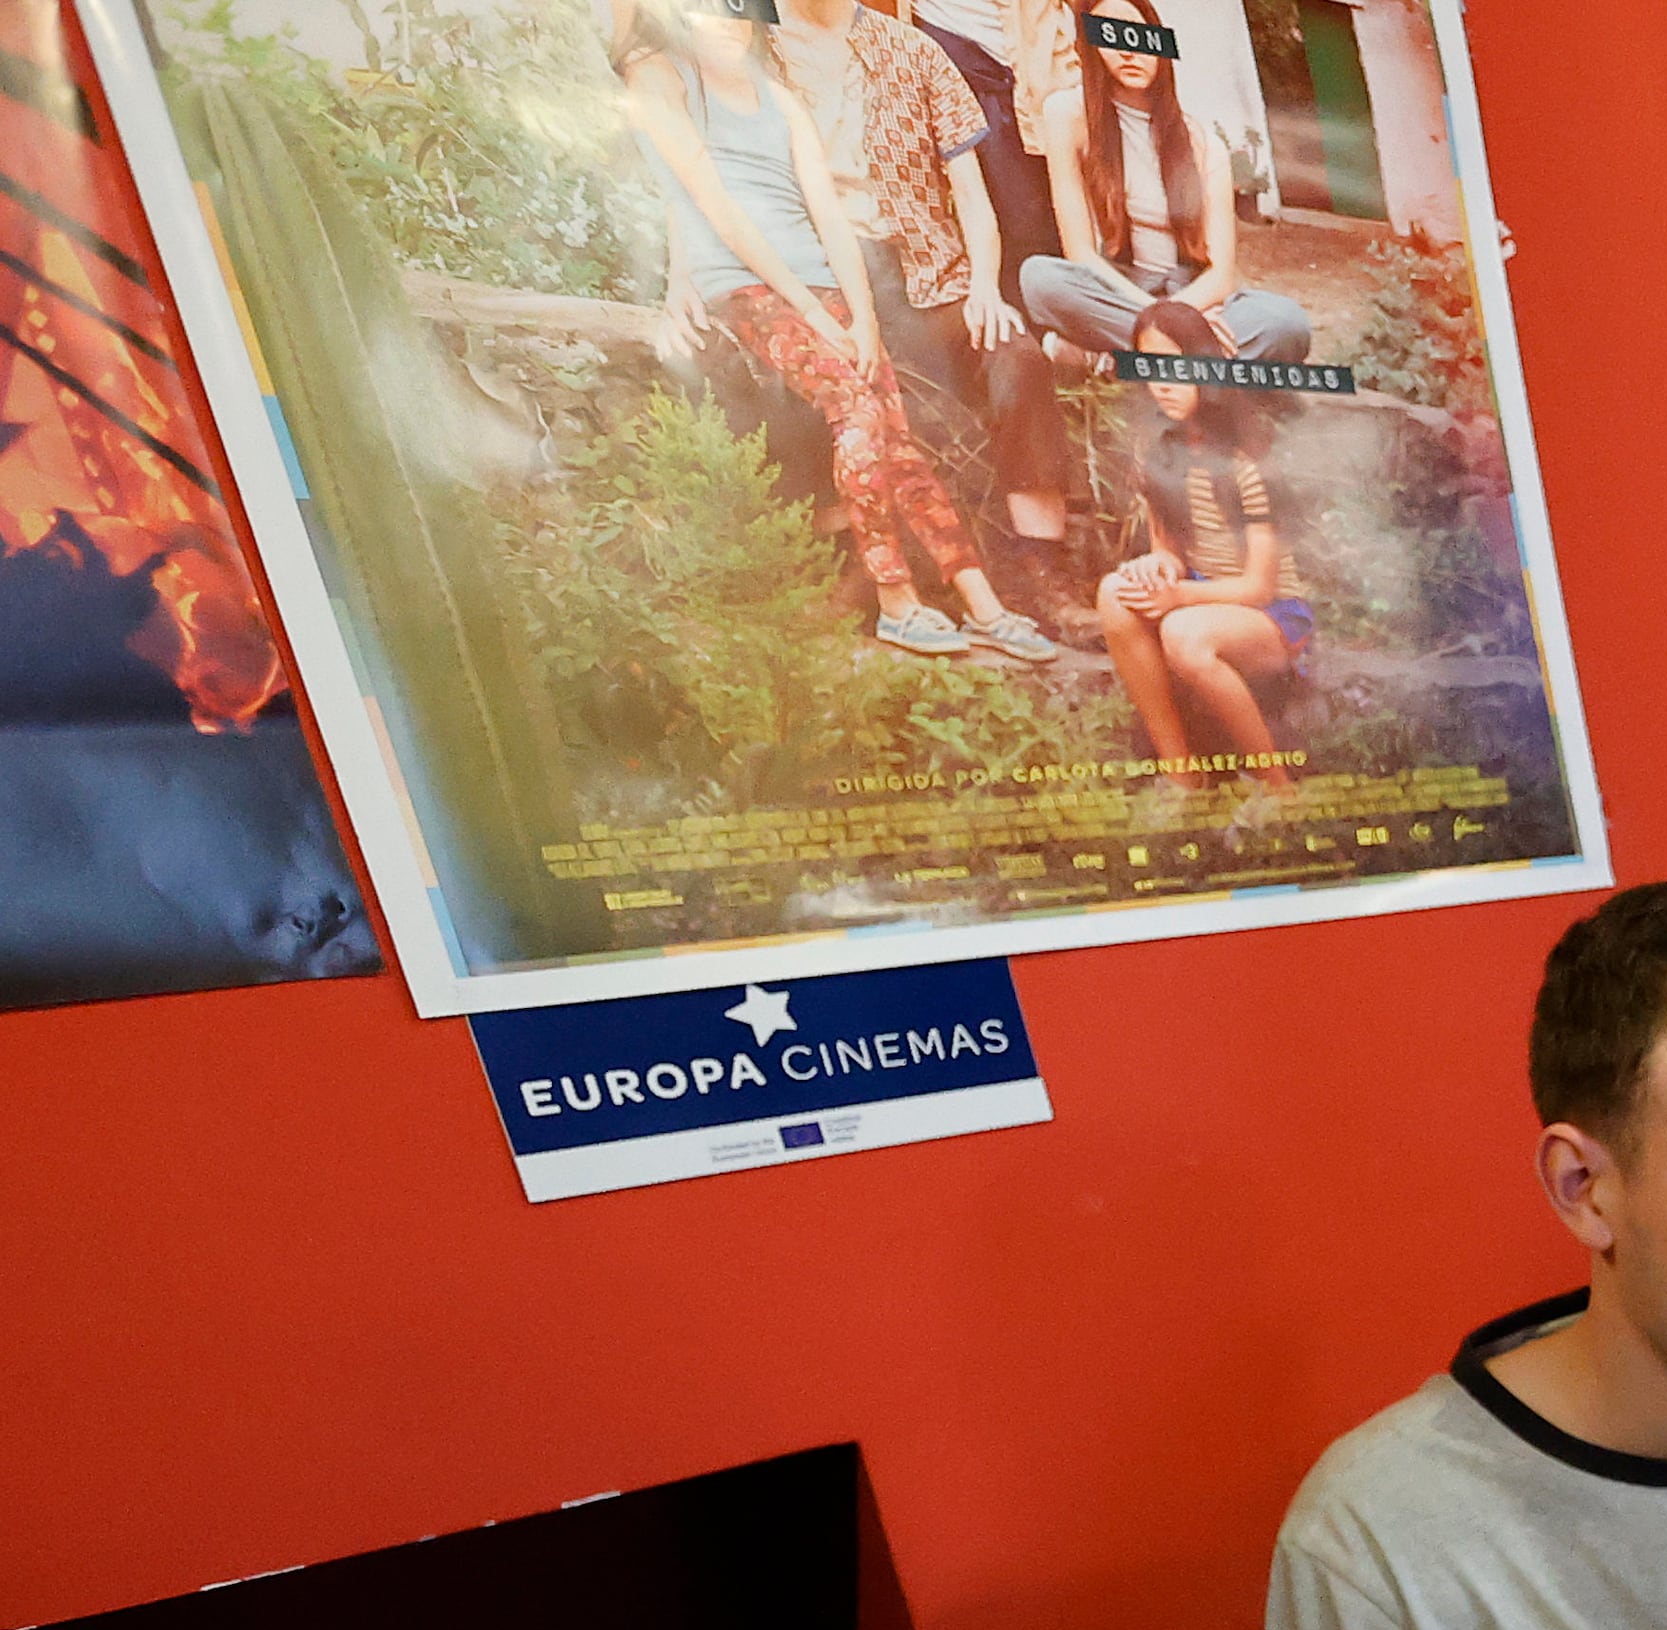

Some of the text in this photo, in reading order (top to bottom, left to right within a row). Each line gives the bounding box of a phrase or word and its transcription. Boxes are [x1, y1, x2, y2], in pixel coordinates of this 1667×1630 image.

[1101, 22, 1162, 52] SON
[1134, 357, 1341, 389] BIENVENIDAS
[834, 771, 945, 794] DIRIGIDA
[1012, 761, 1115, 783] CARLOTA
[520, 1018, 1011, 1117] EUROPA CINEMAS
